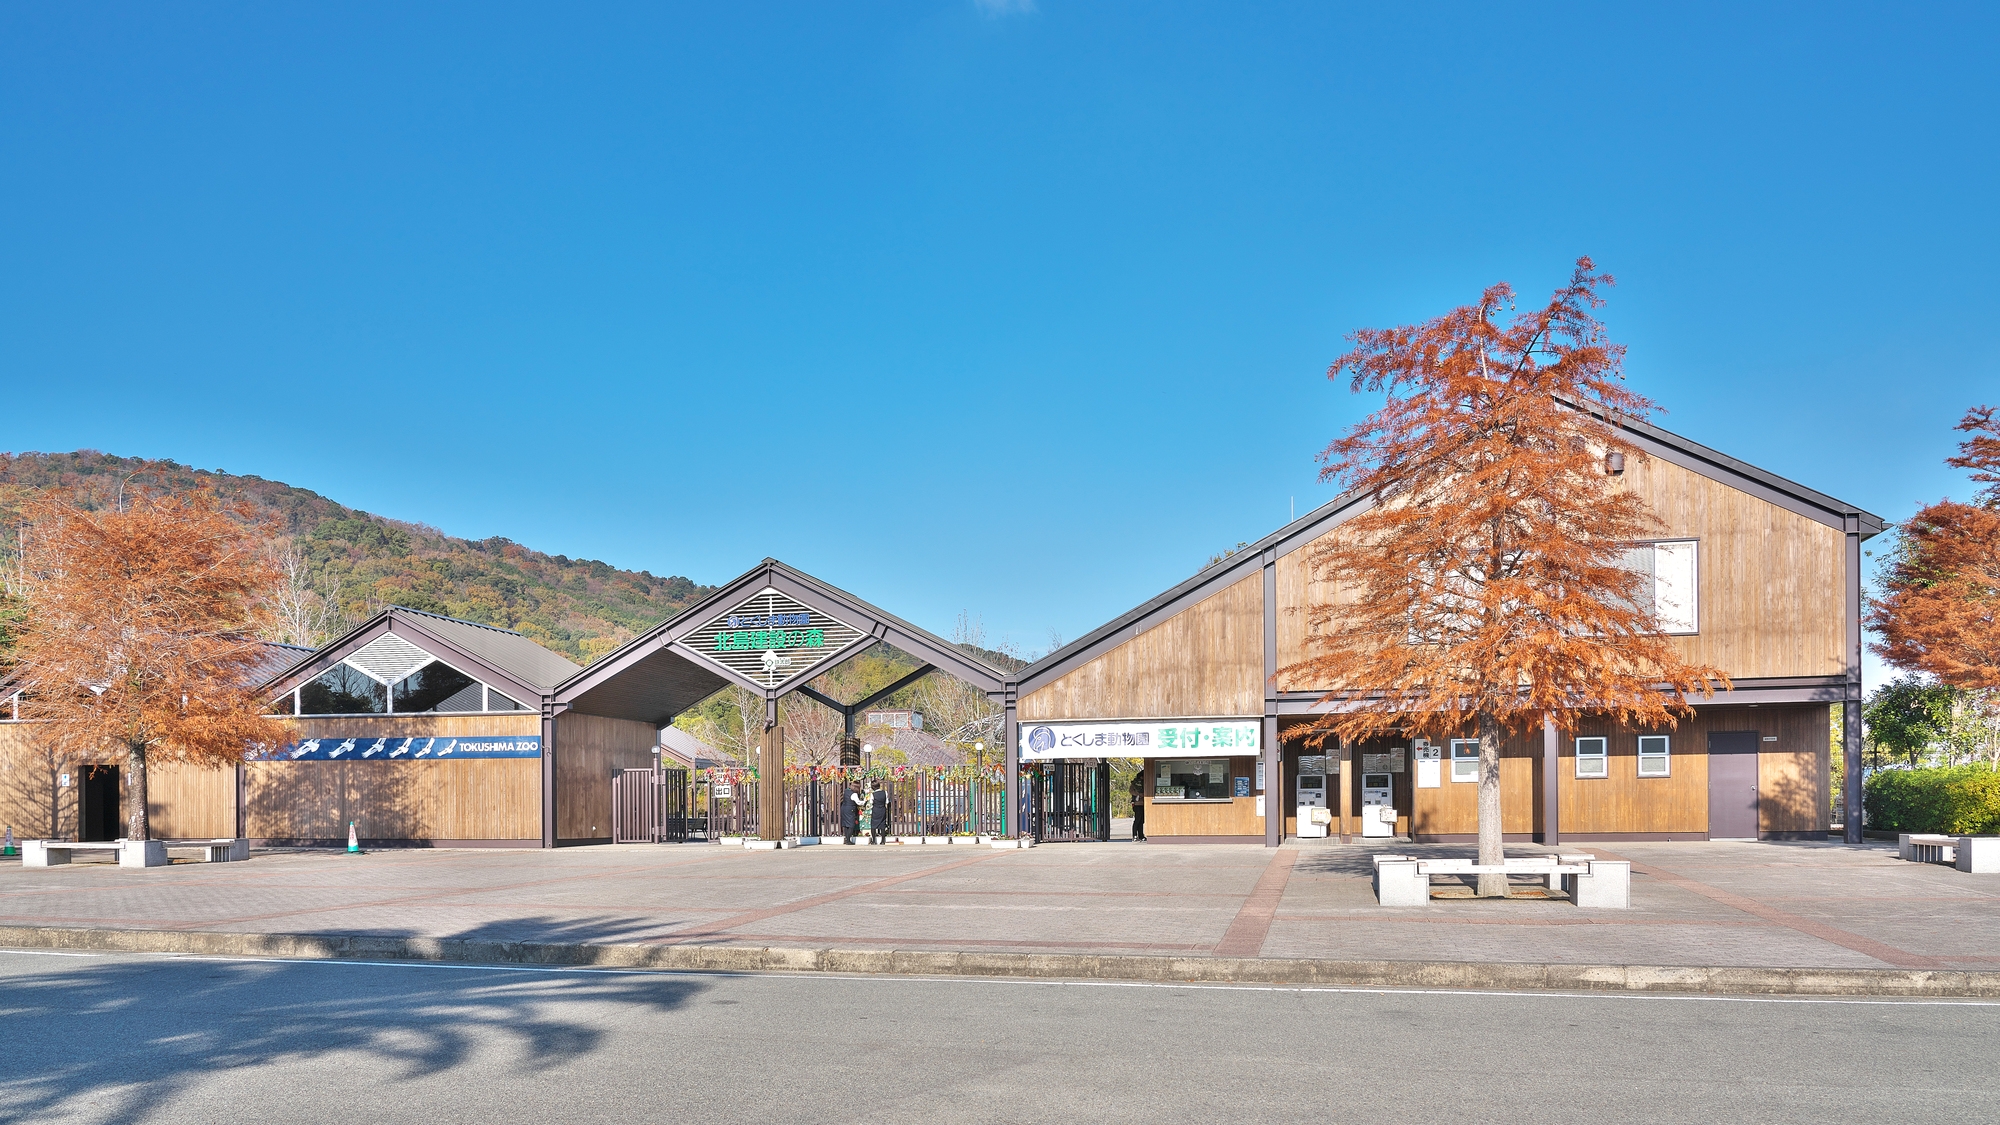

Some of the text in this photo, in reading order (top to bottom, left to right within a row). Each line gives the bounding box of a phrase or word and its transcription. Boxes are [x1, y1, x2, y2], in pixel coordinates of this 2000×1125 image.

[740, 613, 810, 627] とくしま動物園
[714, 628, 824, 651] 北島建設の森
[1060, 726, 1255, 748] とくしま動物園 受付・案内
[459, 742, 538, 751] TOKUSHIMA ZOO
[1432, 748, 1439, 757] 2
